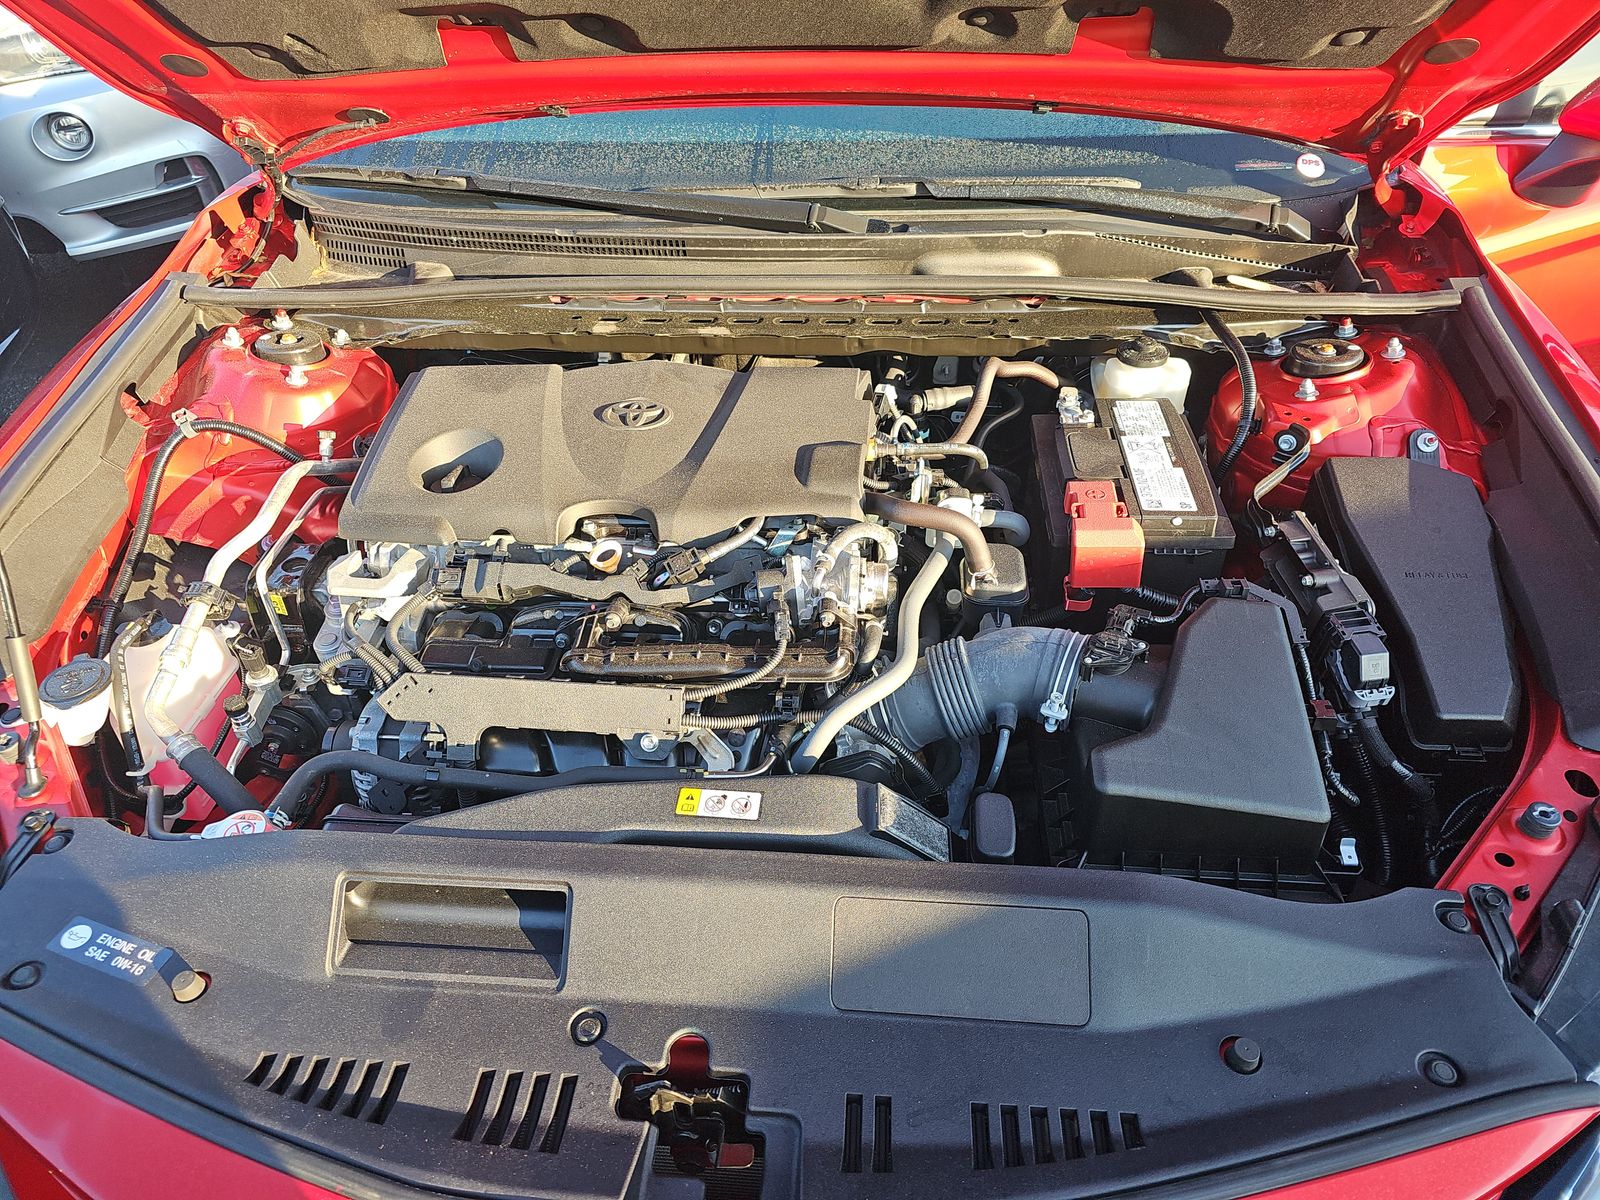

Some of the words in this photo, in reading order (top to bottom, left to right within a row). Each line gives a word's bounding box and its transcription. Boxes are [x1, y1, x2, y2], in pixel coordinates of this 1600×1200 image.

[1301, 158, 1320, 167] DPS
[84, 946, 111, 962] SAE
[110, 956, 147, 976] 0W-16
[96, 934, 137, 955] ENGINE
[137, 949, 157, 963] OIL
